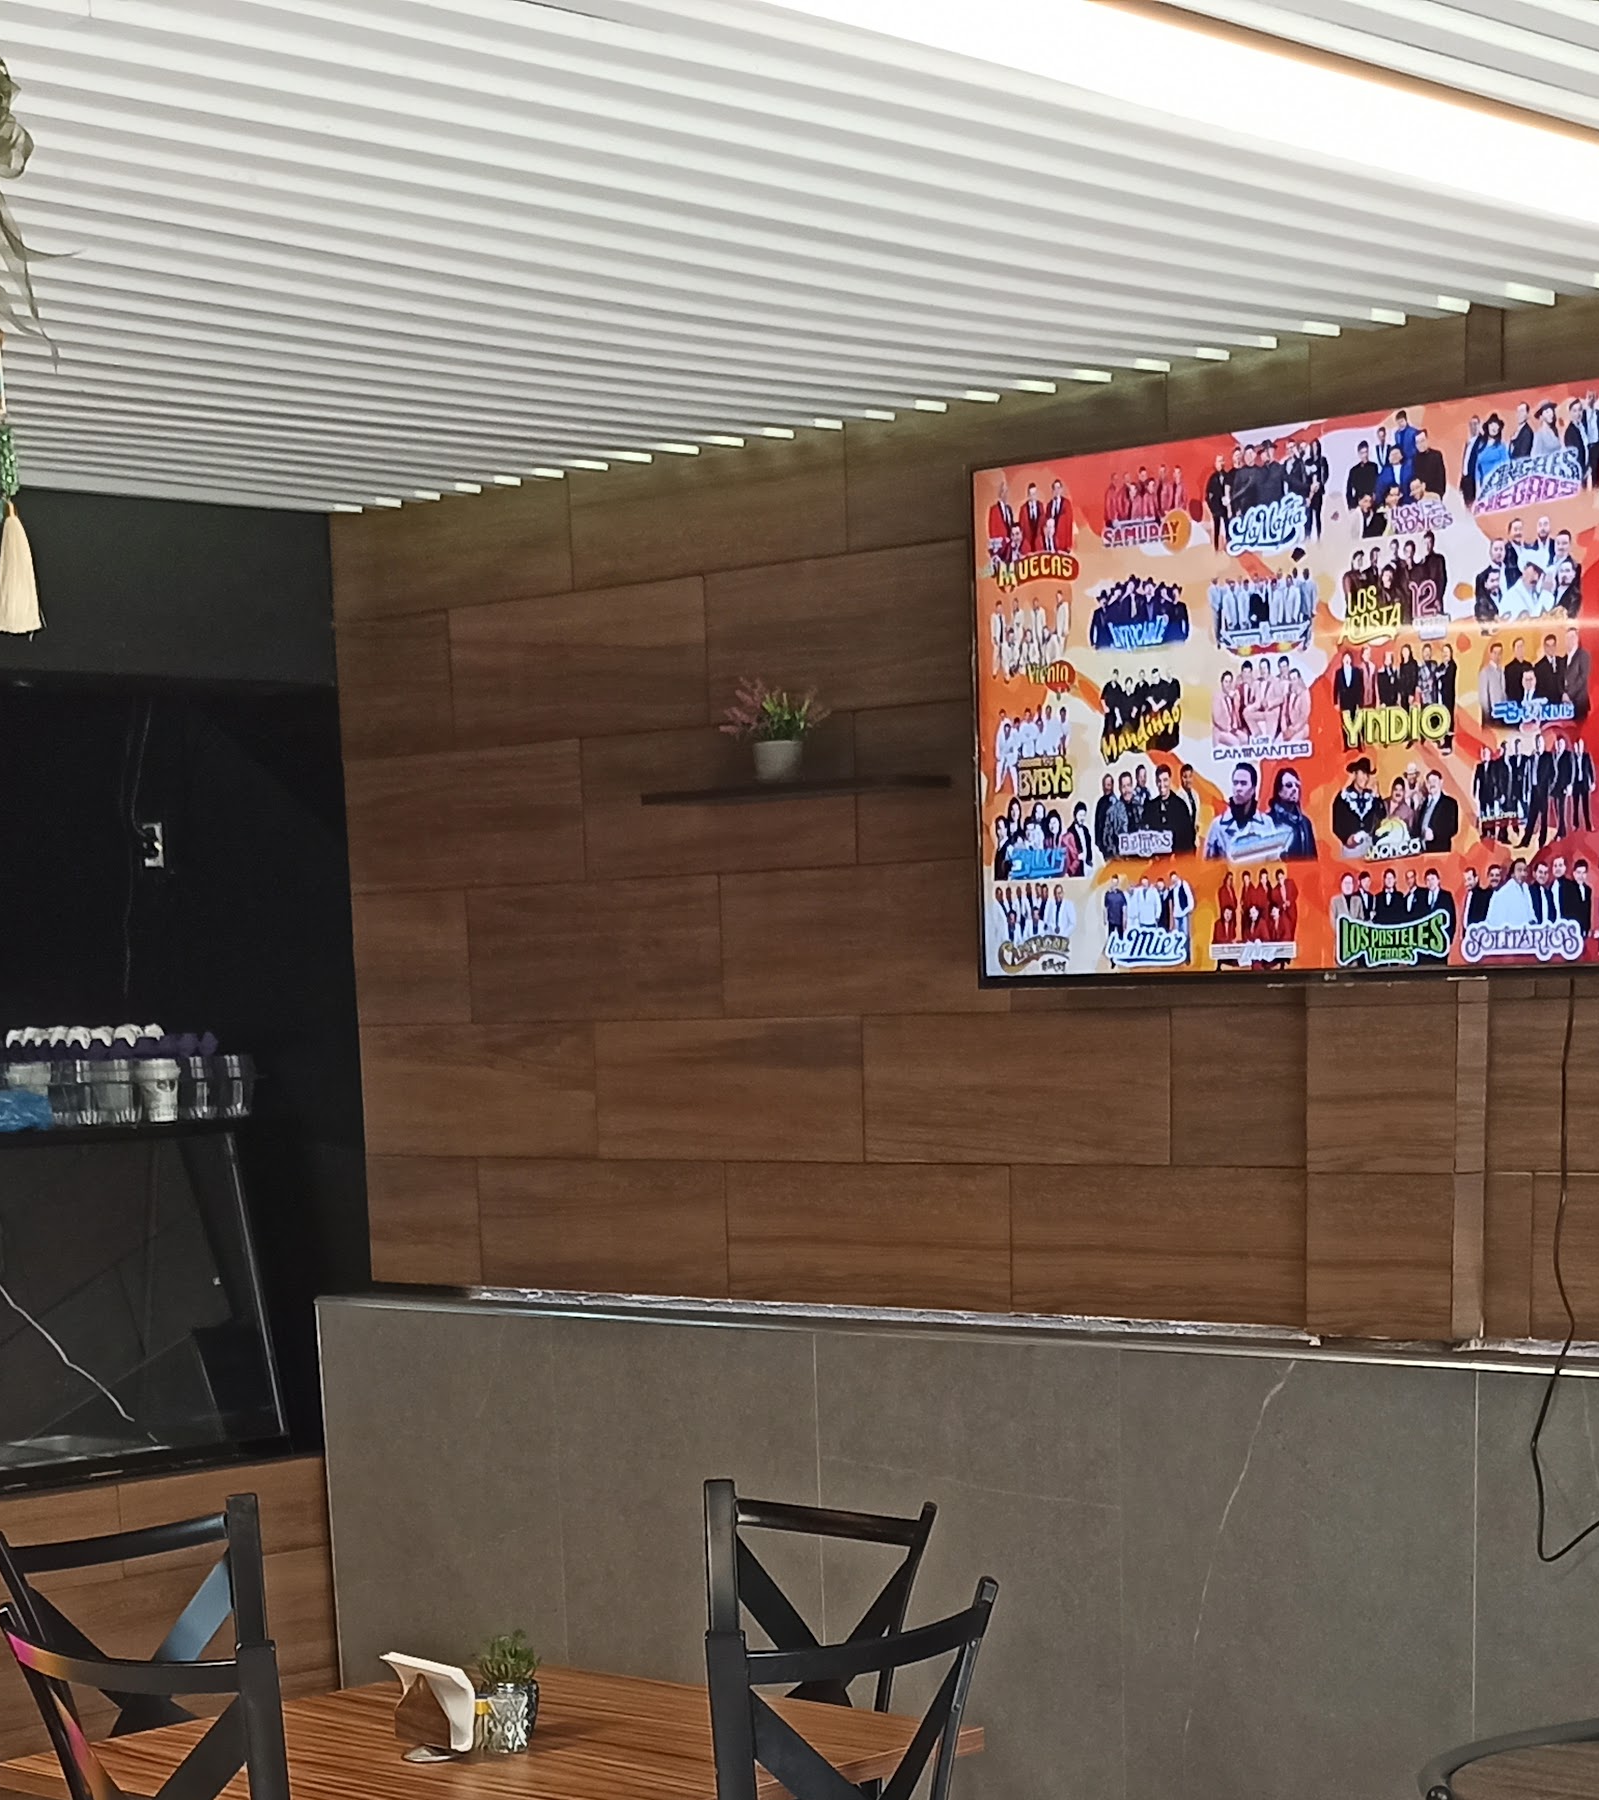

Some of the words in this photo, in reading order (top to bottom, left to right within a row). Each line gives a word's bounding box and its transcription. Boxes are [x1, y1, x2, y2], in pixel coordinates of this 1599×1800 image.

[1474, 475, 1578, 513] NEGROS
[1391, 506, 1420, 521] LOS
[999, 554, 1075, 589] MUECAS
[1348, 586, 1377, 617] LOS
[1338, 603, 1402, 646] ACOSTA
[1101, 704, 1182, 766] Mandingo
[1342, 703, 1451, 748] YNDIO
[1213, 743, 1310, 760] CAMINANTES
[1126, 930, 1184, 962] Mier
[1342, 920, 1370, 960] LOS
[1371, 913, 1445, 953] PASTELES
[1369, 946, 1414, 963] VERDES
